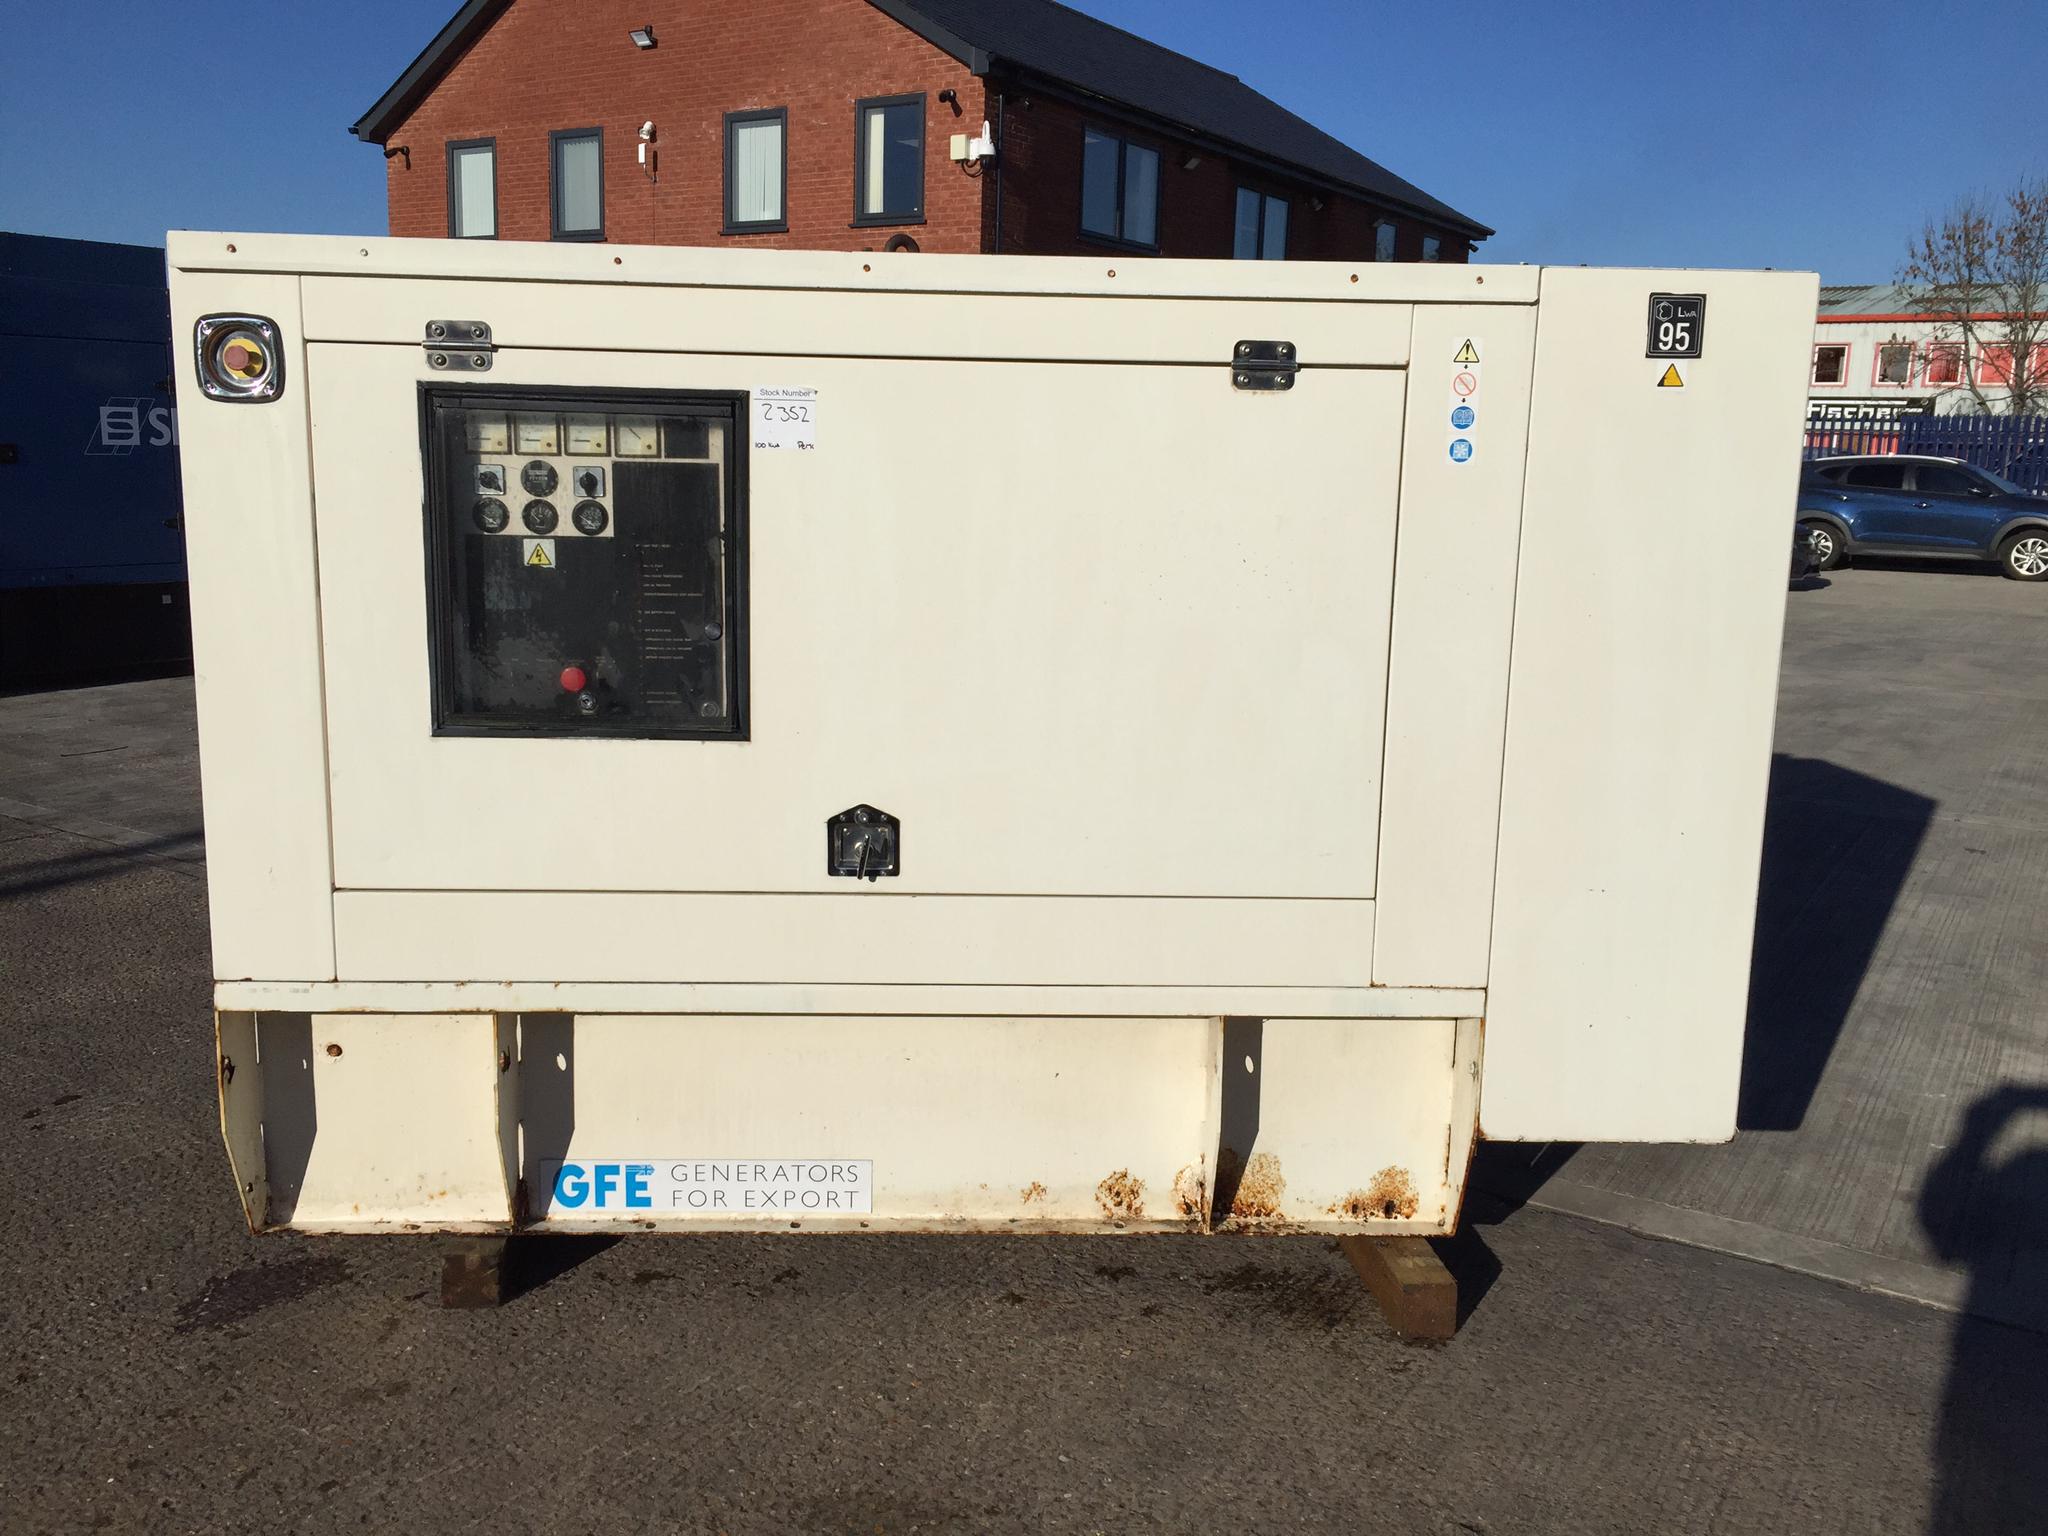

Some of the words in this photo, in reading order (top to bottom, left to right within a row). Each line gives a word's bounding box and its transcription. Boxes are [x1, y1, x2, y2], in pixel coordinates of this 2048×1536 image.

[1658, 321, 1691, 351] 95
[760, 388, 780, 396] Stock
[782, 388, 811, 397] Number
[761, 402, 810, 422] 2352
[671, 1164, 859, 1183] GENERATORS
[553, 1163, 653, 1208] GFE
[672, 1190, 728, 1208] FOR
[744, 1190, 860, 1208] EXPORT
